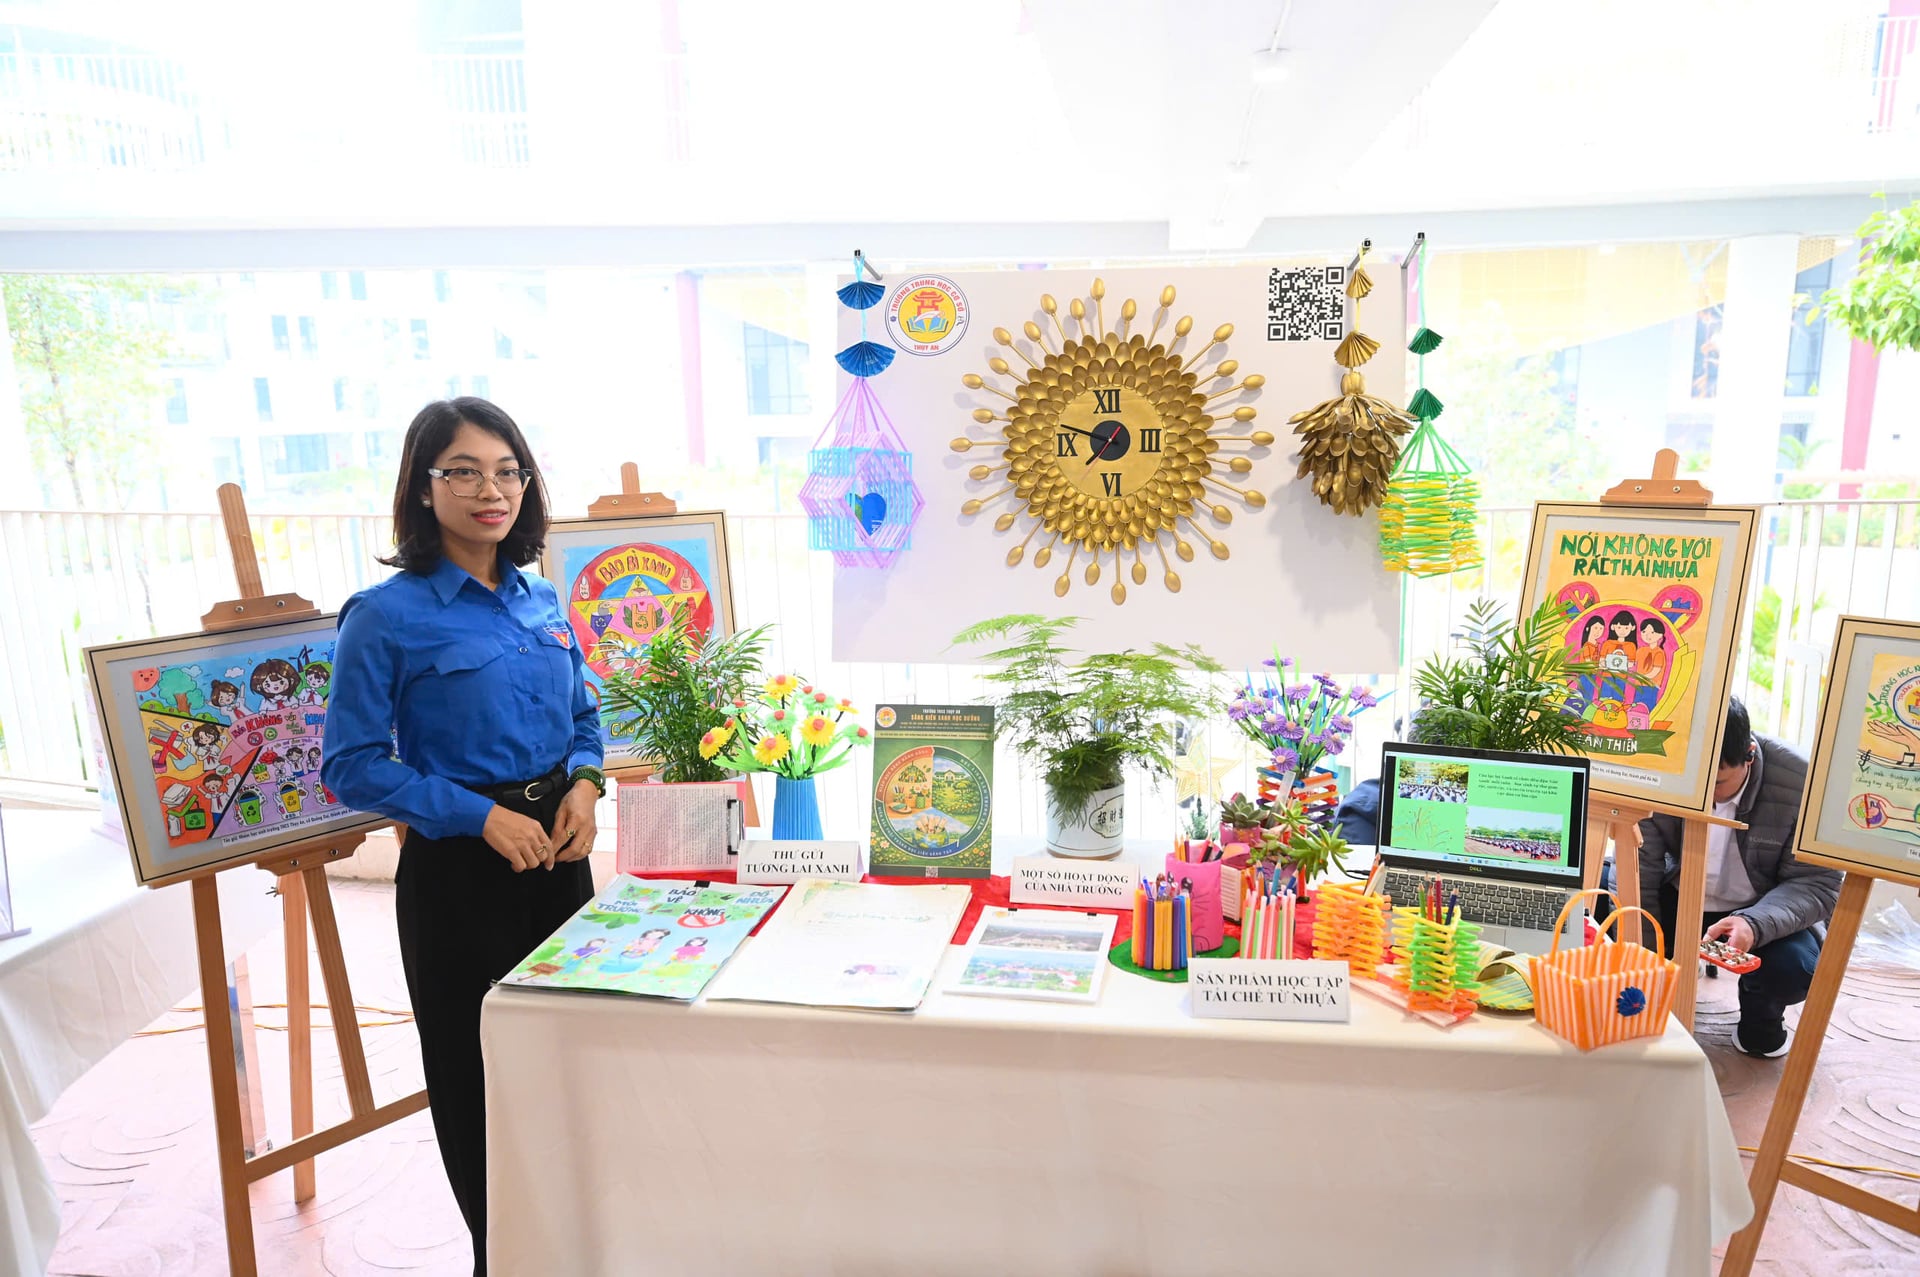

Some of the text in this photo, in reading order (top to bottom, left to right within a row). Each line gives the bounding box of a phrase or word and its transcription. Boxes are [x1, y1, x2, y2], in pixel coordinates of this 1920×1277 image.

[1092, 389, 1122, 414] XII
[1056, 433, 1078, 457] IX
[1139, 428, 1162, 453] III
[1100, 472, 1122, 497] VI
[1560, 532, 1598, 557] NÓI
[1603, 533, 1678, 557] KHÔNG
[599, 559, 624, 582] BAO
[792, 864, 811, 873] LAI
[816, 864, 849, 873] XANH
[1277, 976, 1311, 989] HỌC
